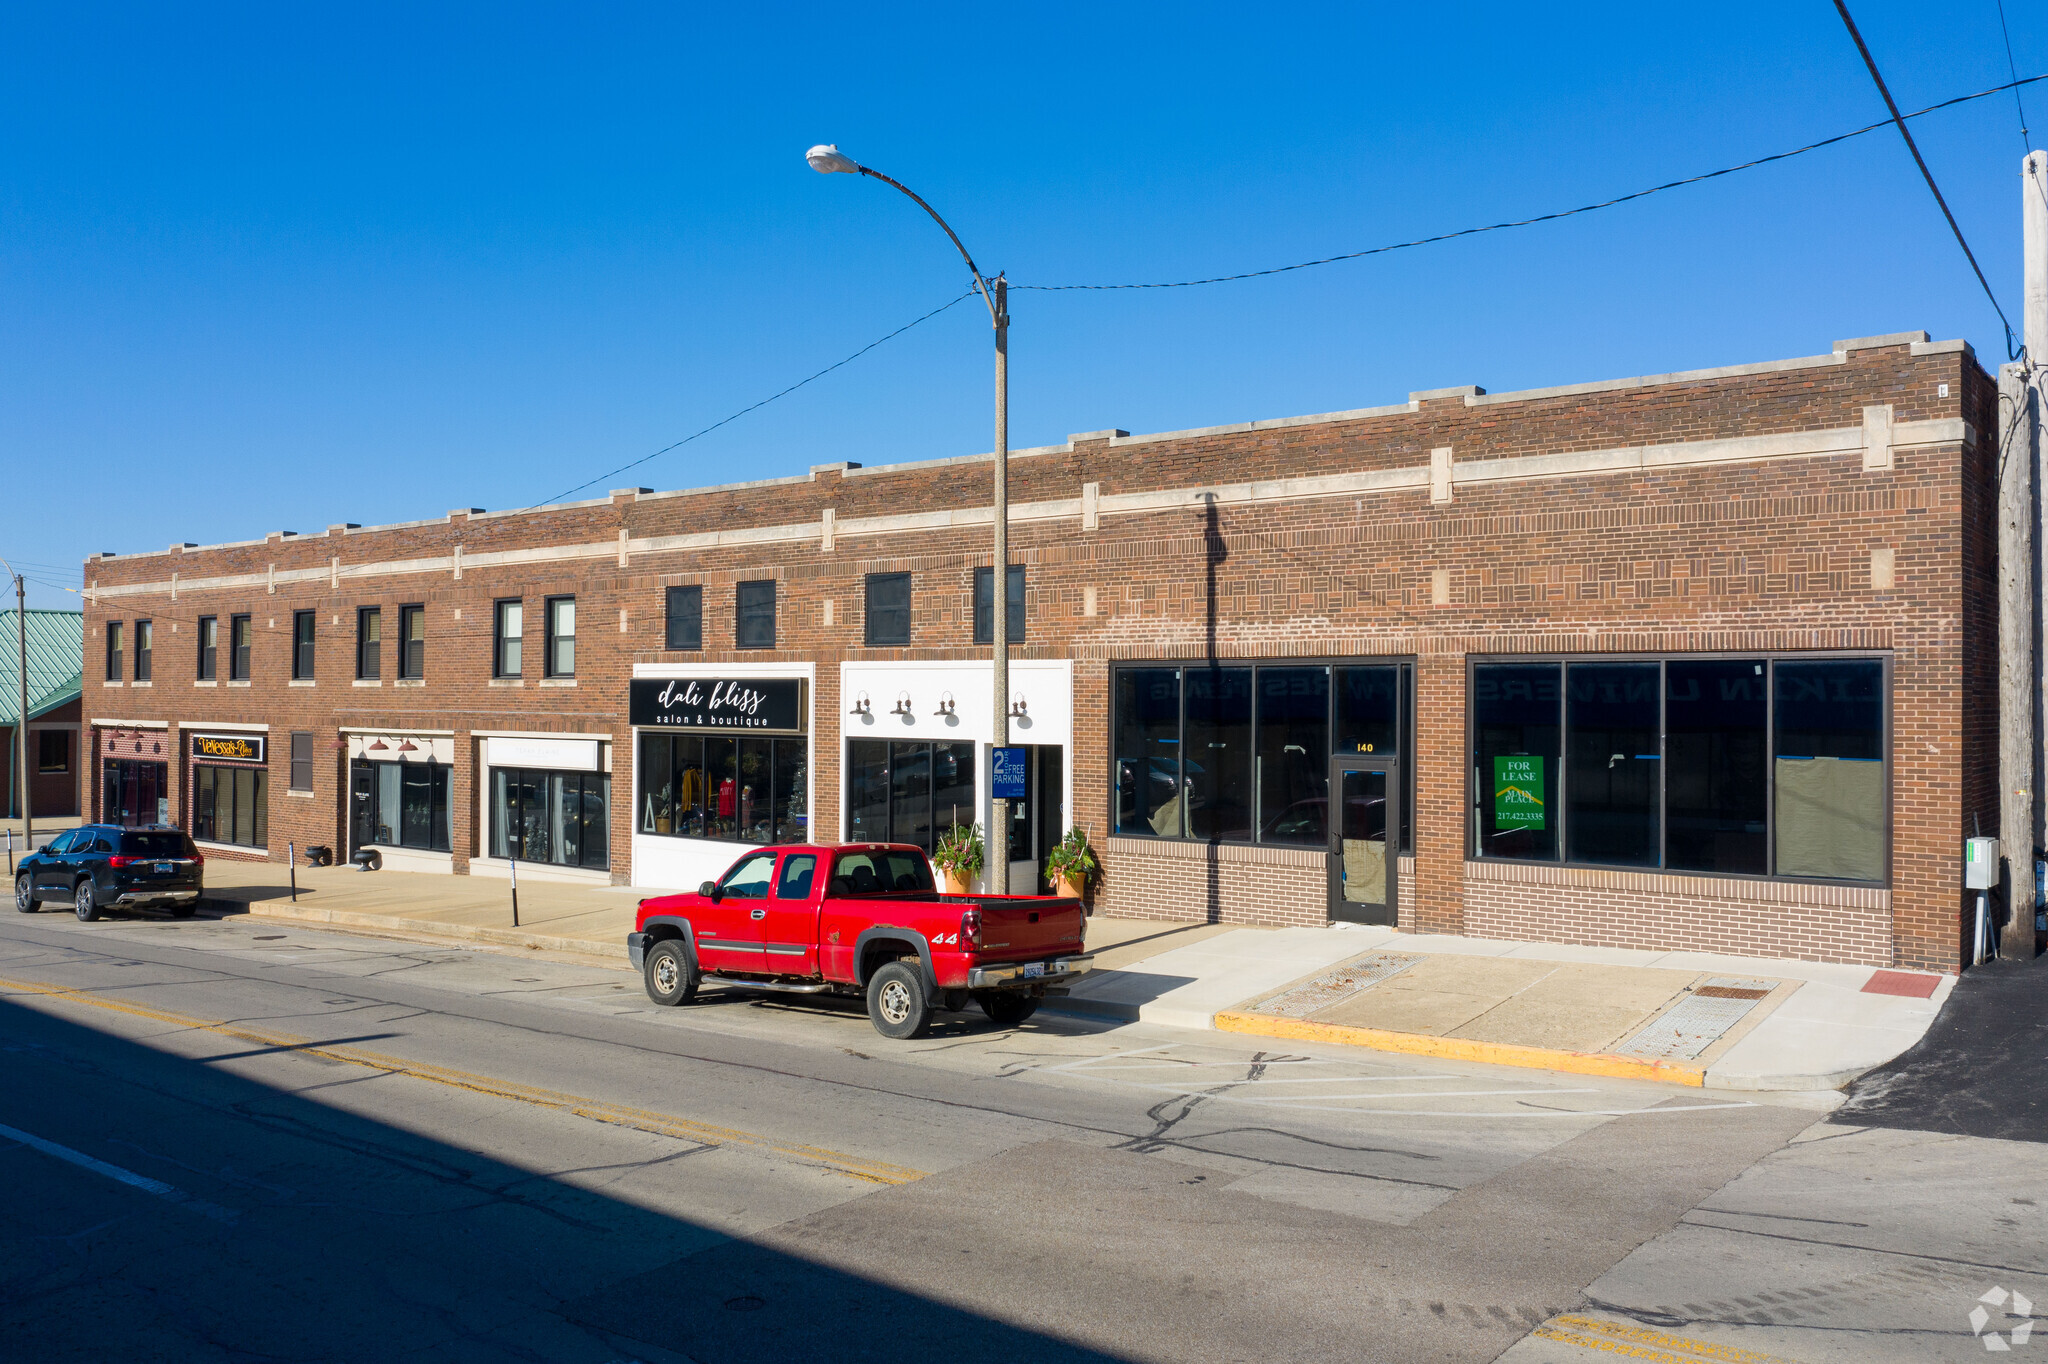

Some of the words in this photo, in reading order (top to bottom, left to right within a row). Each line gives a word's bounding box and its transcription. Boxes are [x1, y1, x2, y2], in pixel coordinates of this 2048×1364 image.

[658, 680, 703, 708] dali
[708, 680, 767, 715] bliss
[657, 714, 689, 724] salon
[697, 714, 702, 724] &
[710, 715, 768, 728] boutique
[1357, 743, 1374, 753] 140
[994, 751, 1005, 775] 2
[1009, 765, 1024, 774] FREE
[1508, 762, 1531, 771] FOR
[994, 775, 1025, 785] PARKING
[1502, 772, 1537, 782] LEASE
[1507, 790, 1532, 798] MAIN
[1505, 796, 1535, 804] PLACE
[1498, 813, 1544, 821] 217.422.3335
